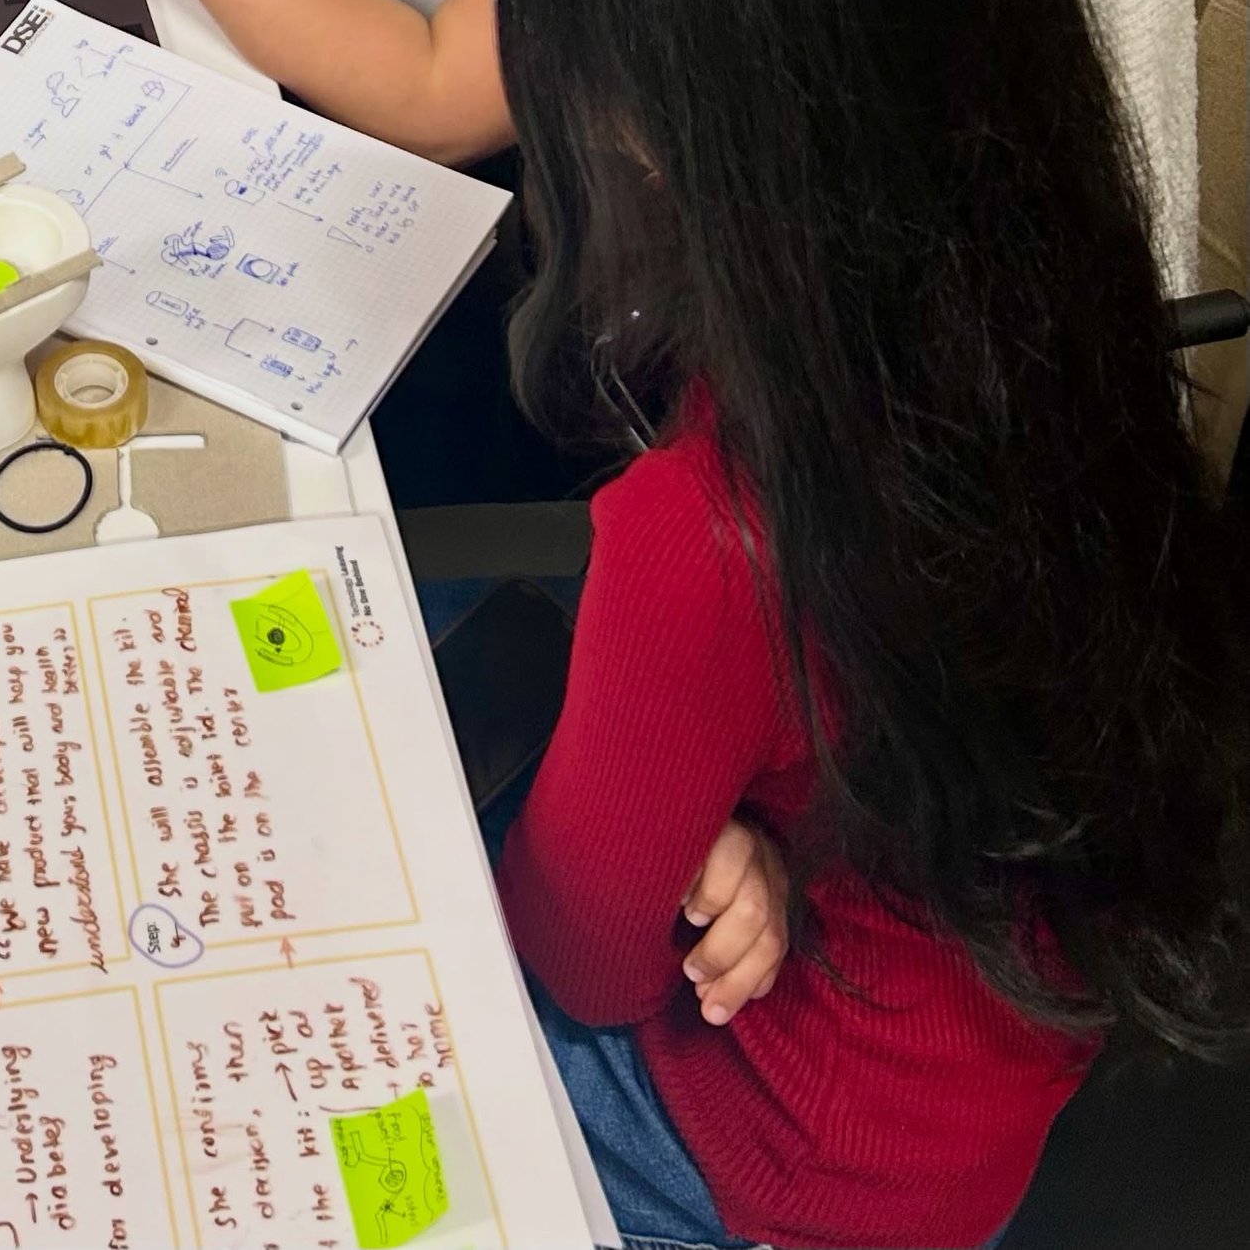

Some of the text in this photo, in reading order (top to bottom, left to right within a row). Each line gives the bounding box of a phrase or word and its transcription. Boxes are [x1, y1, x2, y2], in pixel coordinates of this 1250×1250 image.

[336, 545, 350, 578] Leaving
[350, 559, 366, 586] Behind
[2, 623, 25, 657] you
[12, 715, 33, 753] will
[55, 740, 82, 787] body
[150, 806, 173, 843] will
[218, 813, 238, 843] the
[256, 812, 274, 838] on
[24, 815, 60, 888] product
[258, 848, 277, 864] is
[235, 861, 252, 887] on
[61, 845, 108, 975] understand
[199, 890, 221, 928] The
[269, 880, 297, 922] pad
[36, 907, 57, 958] new
[147, 921, 162, 955] Step:
[349, 977, 399, 1068] delivered
[224, 1021, 249, 1083] then
[306, 1057, 334, 1088] up
[1, 1044, 40, 1184] Underlying
[88, 1053, 124, 1197] developing
[312, 1185, 334, 1219] the
